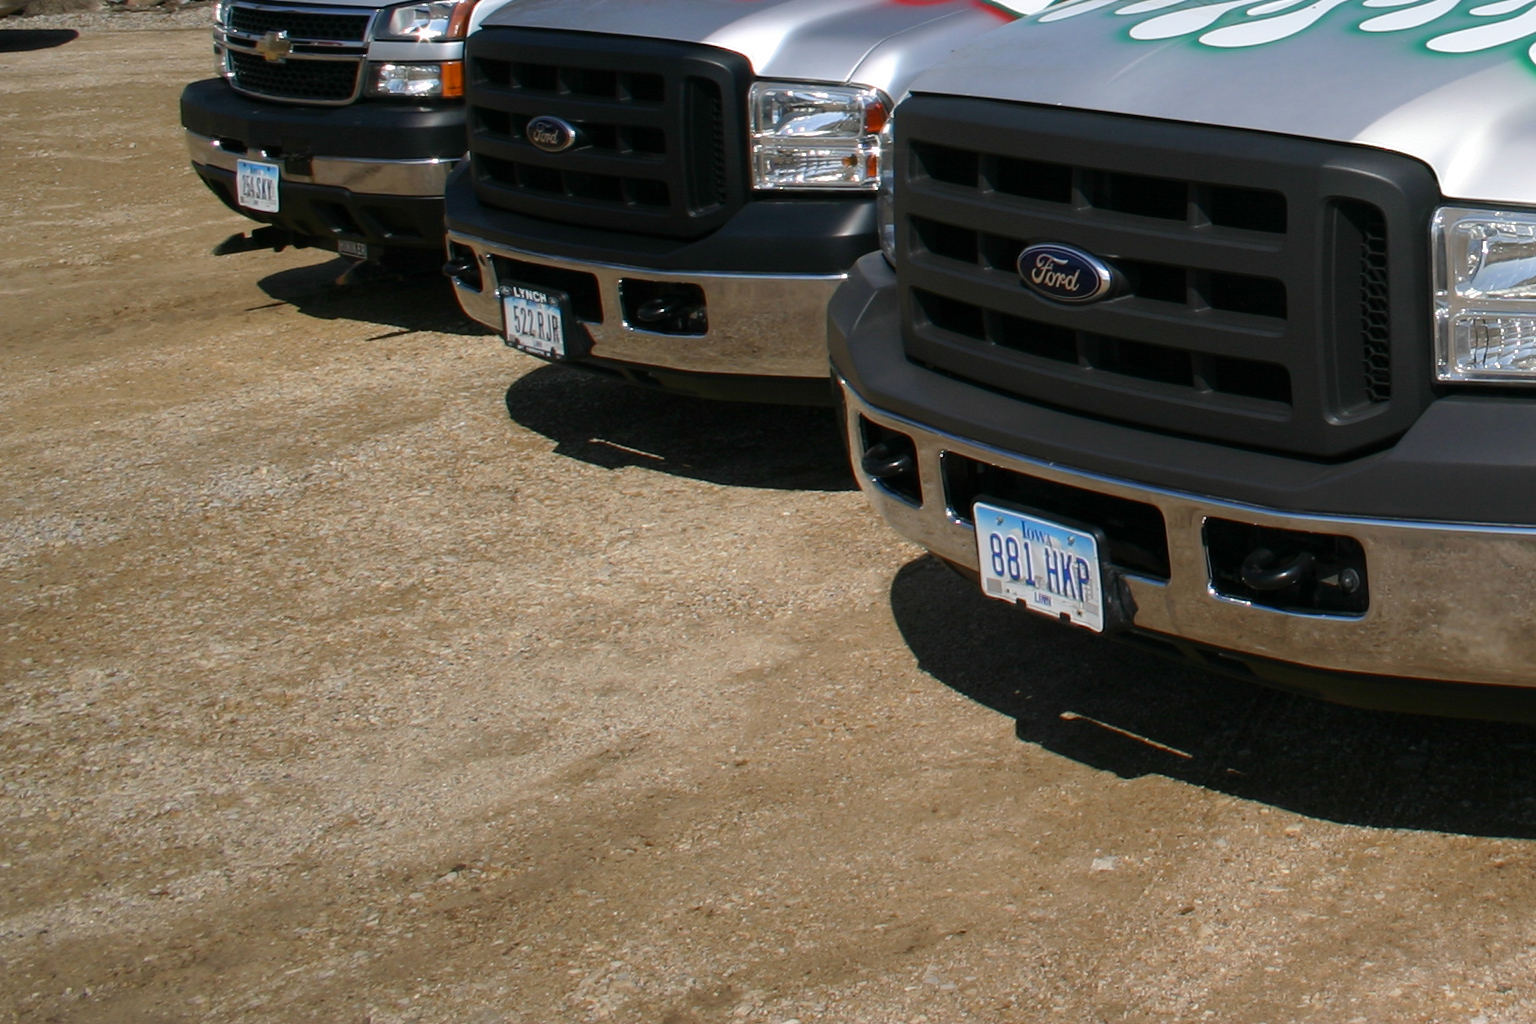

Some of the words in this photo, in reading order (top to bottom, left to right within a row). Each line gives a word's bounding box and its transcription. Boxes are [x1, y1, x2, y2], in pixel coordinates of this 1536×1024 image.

[533, 121, 559, 145] Ford
[1031, 253, 1081, 292] Ford
[513, 286, 547, 303] LYNCH
[513, 305, 534, 336] 522
[1021, 520, 1053, 547] IOWA
[990, 532, 1036, 586] 881
[1044, 546, 1089, 603] HKP
